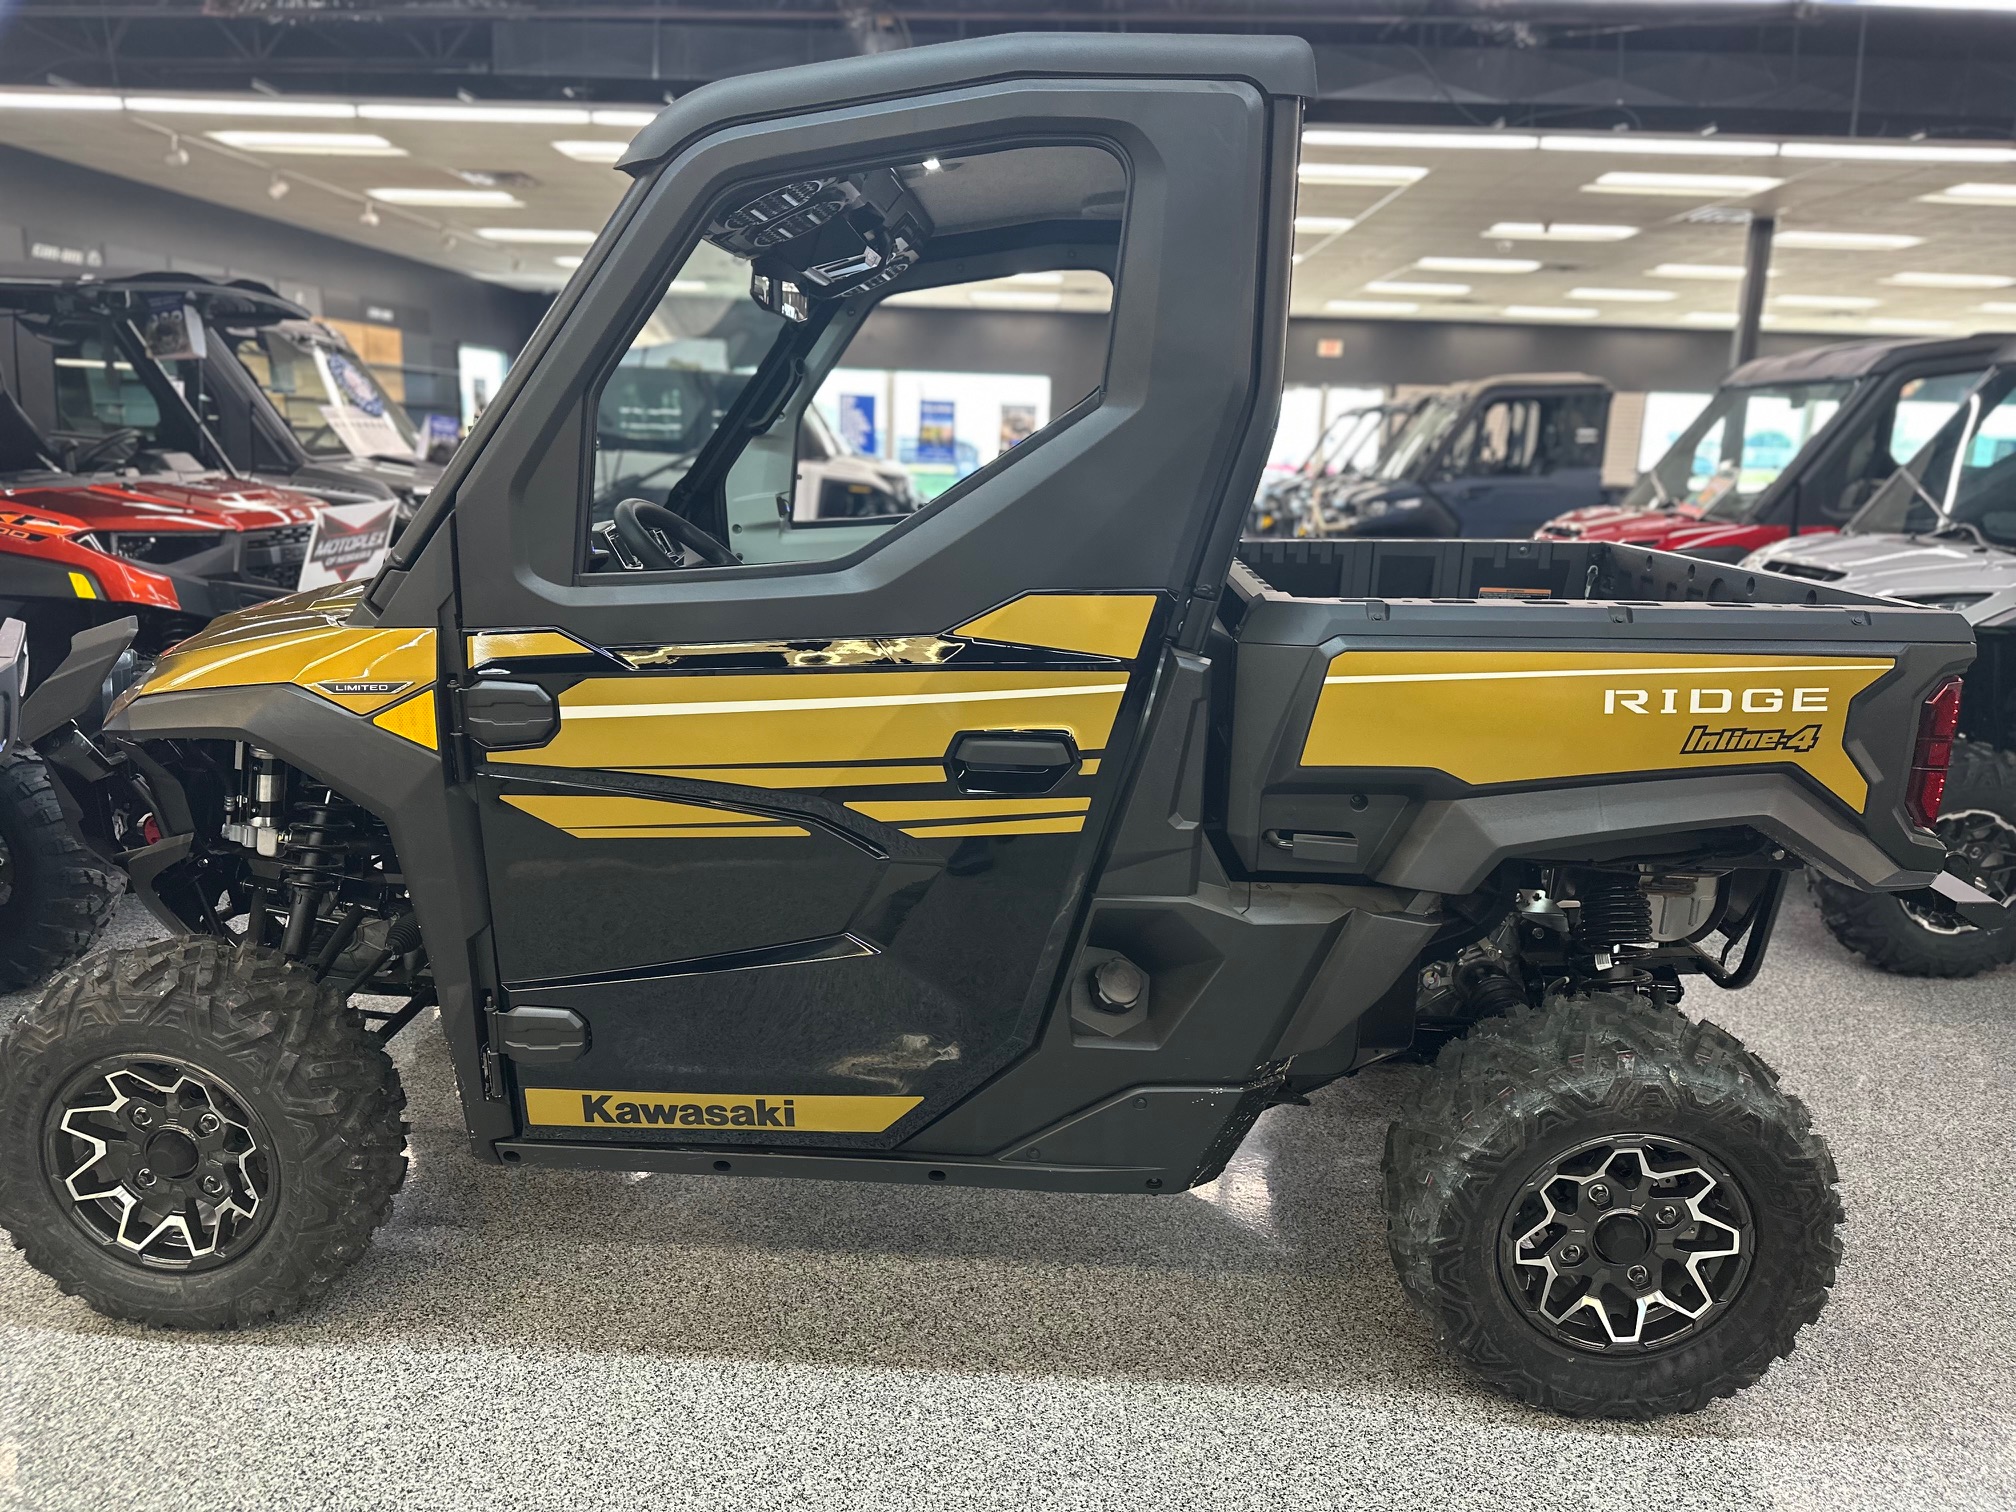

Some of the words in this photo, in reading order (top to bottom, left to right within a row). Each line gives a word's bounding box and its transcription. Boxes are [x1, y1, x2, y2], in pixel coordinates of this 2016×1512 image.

[313, 531, 387, 558] MOTOPLEX
[335, 684, 389, 692] LIMITED
[1604, 687, 1829, 714] RIDGE
[1680, 724, 1822, 754] Inline-4
[581, 1094, 796, 1127] Kawasaki
